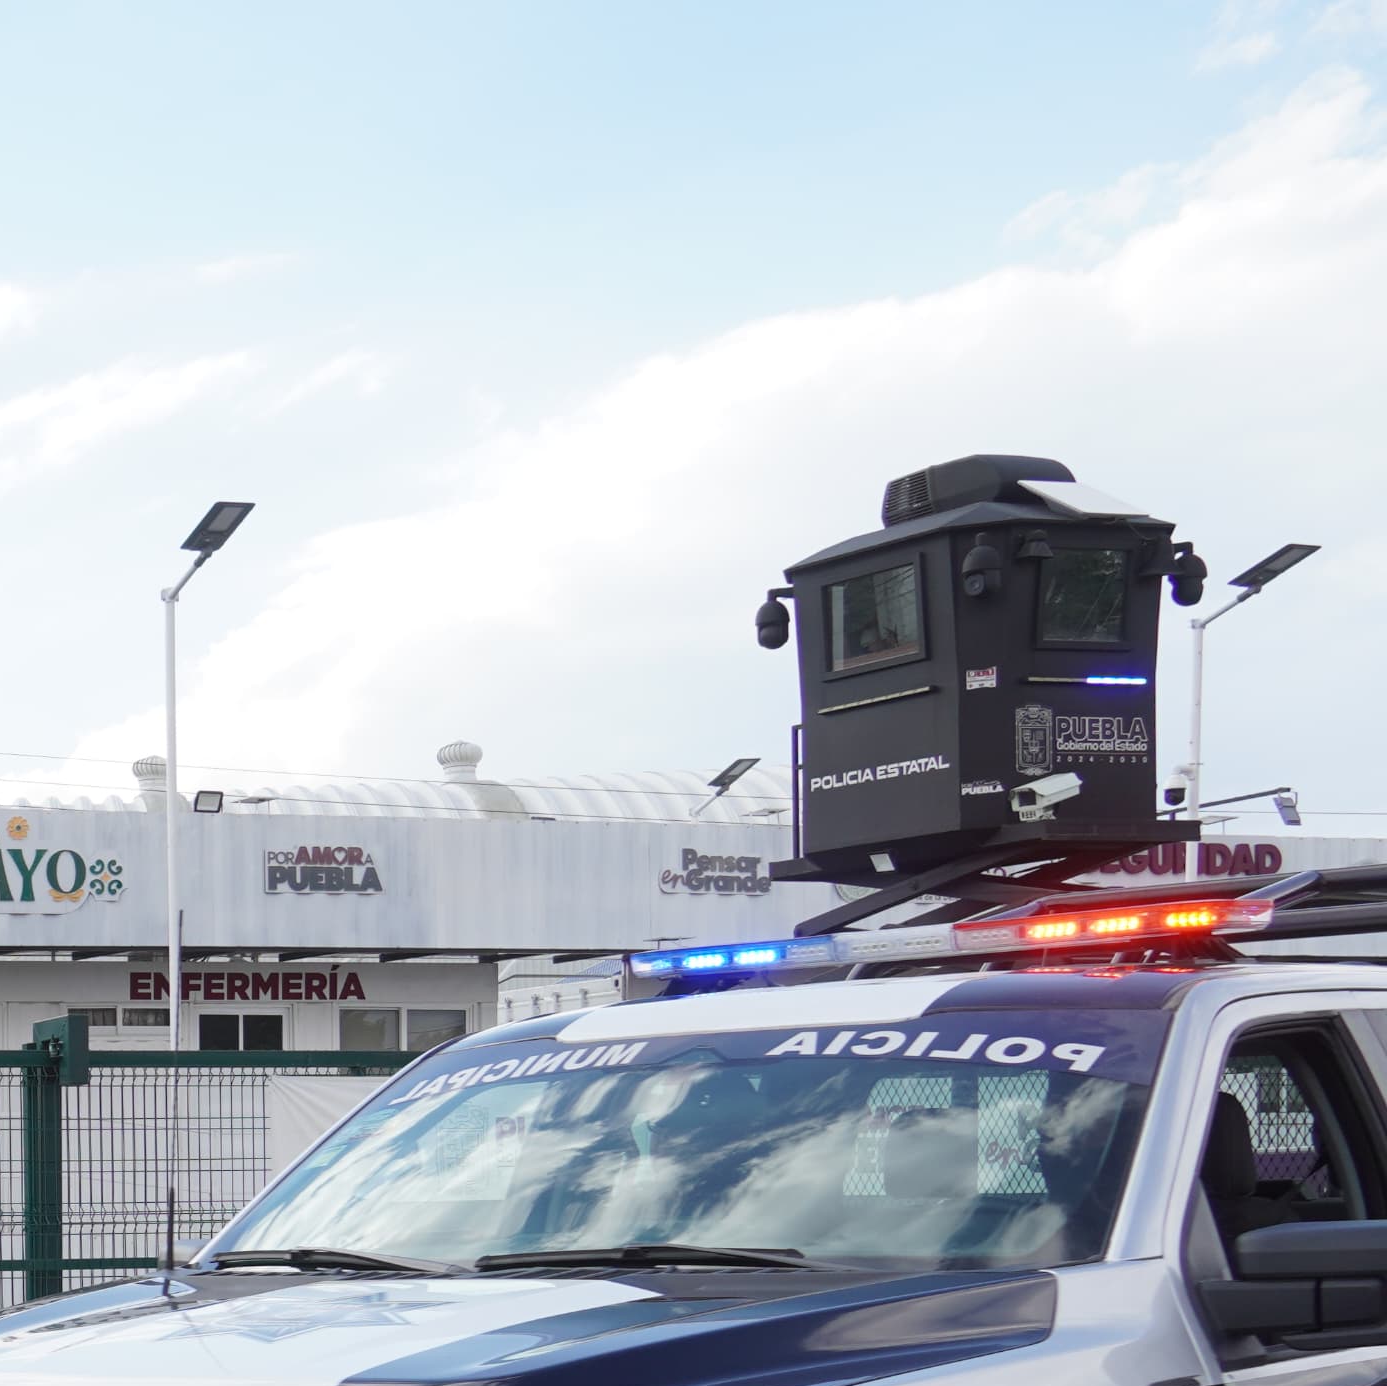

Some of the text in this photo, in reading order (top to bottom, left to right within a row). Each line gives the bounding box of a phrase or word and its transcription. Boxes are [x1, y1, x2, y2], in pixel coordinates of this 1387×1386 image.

[1055, 716, 1148, 741] PUEBLA
[1056, 741, 1147, 751] Gobierno del Estado
[811, 755, 950, 792] POLICIA ESTATAL
[961, 784, 1005, 796] PUEBLA
[267, 846, 374, 866] POR AMOR A
[682, 848, 761, 872] Pensar
[267, 866, 383, 892] PUEBLA
[661, 868, 772, 893] en Grande
[130, 965, 366, 1000] ENFERMERÍA
